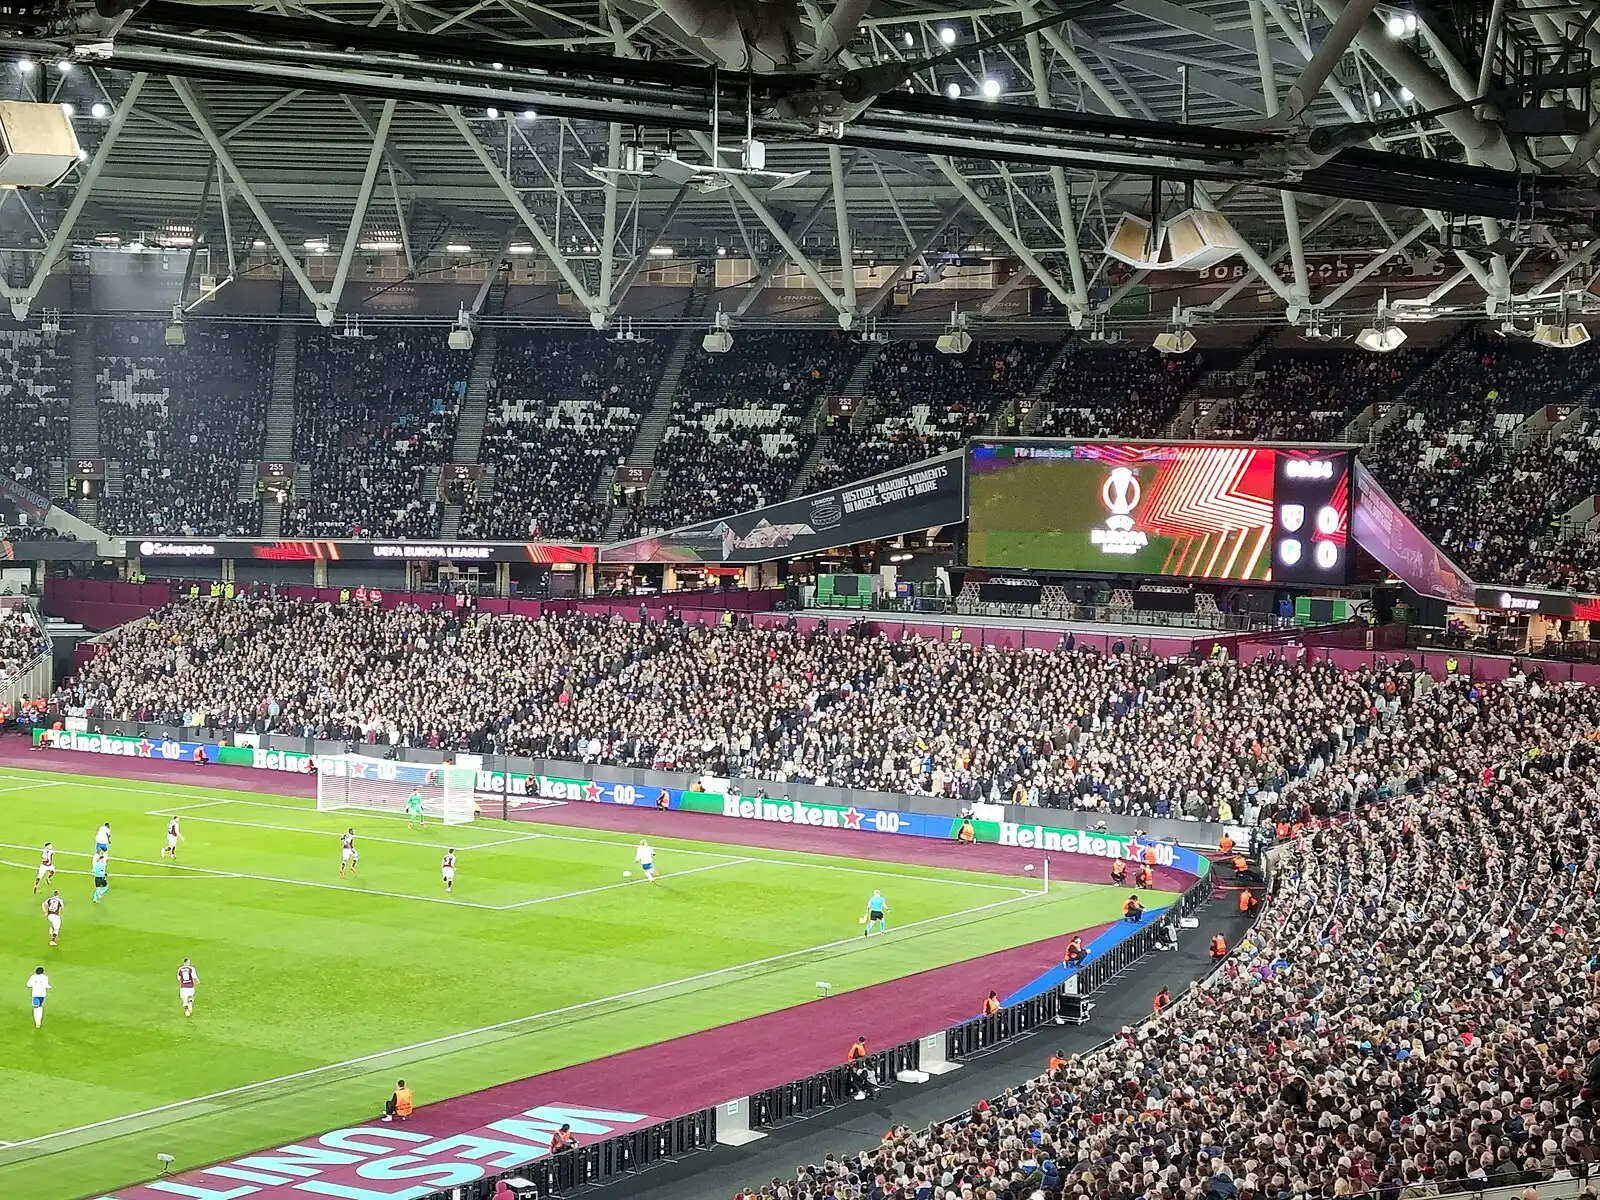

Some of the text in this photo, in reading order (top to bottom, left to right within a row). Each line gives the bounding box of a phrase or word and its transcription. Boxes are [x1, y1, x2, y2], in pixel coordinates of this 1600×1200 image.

[1019, 400, 1032, 408] 251
[77, 459, 94, 468] 256
[268, 463, 284, 471] 255
[454, 466, 469, 474] 254
[628, 469, 643, 477] 253
[841, 465, 948, 503] HISTORY-MAKING MOMENTS
[843, 502, 854, 514] IN
[854, 495, 882, 513] MUSIC,
[881, 486, 907, 505] SPORT
[915, 479, 938, 495] MORE
[1318, 506, 1340, 535] 0
[153, 543, 215, 557] Swissquote
[373, 546, 403, 557] UEFA
[403, 546, 447, 558] EUROPA
[1317, 540, 1338, 568] 0
[1511, 599, 1541, 610] JUST EAT
[475, 770, 582, 801] Heinken
[722, 792, 839, 828] Heineken
[998, 822, 1123, 860] Heineken
[130, 1127, 434, 1200] UNIT
